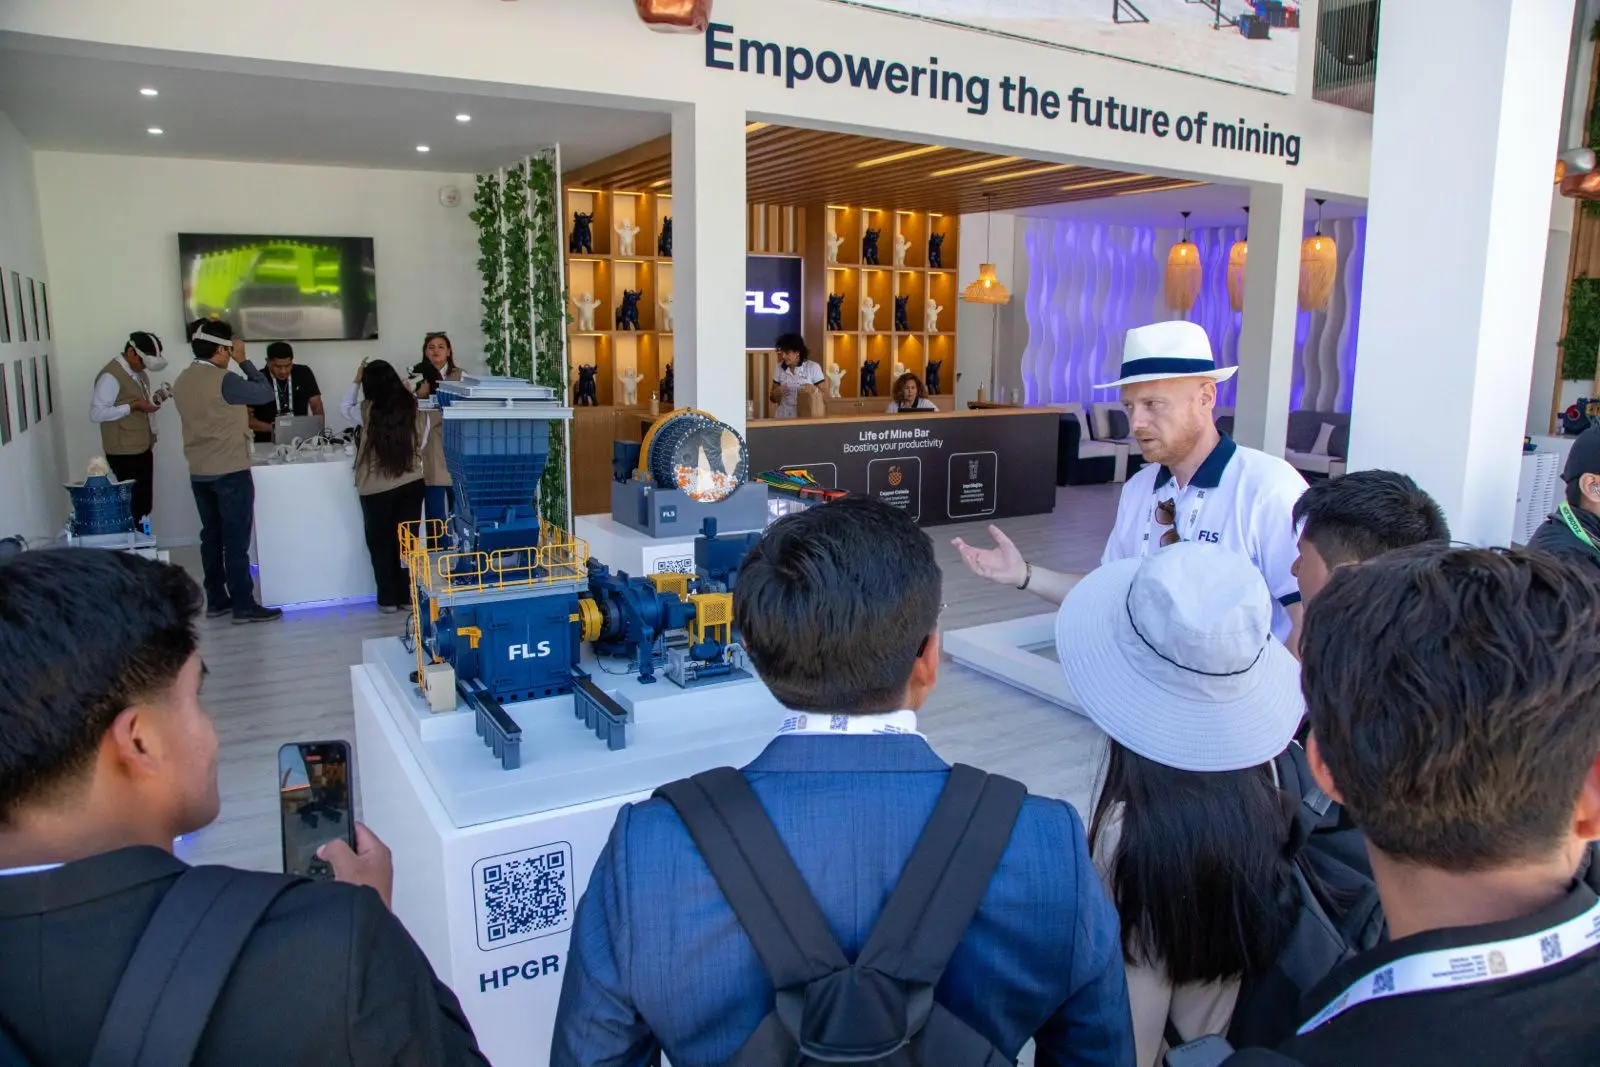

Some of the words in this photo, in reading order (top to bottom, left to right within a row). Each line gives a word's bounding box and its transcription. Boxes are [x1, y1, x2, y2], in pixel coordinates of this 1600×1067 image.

[705, 22, 989, 115] Empowering
[999, 76, 1060, 119] the
[1068, 87, 1169, 137] future
[1175, 111, 1207, 144] of
[1212, 118, 1300, 165] mining
[859, 431, 877, 441] Life
[878, 430, 889, 440] of
[890, 428, 913, 439] Mine
[914, 428, 930, 438] Bar
[843, 443, 879, 453] Boosting
[880, 441, 897, 452] your
[898, 439, 943, 451] productivity
[1198, 530, 1219, 543] FLS
[508, 640, 551, 660] FLS
[479, 954, 559, 992] HPGR
